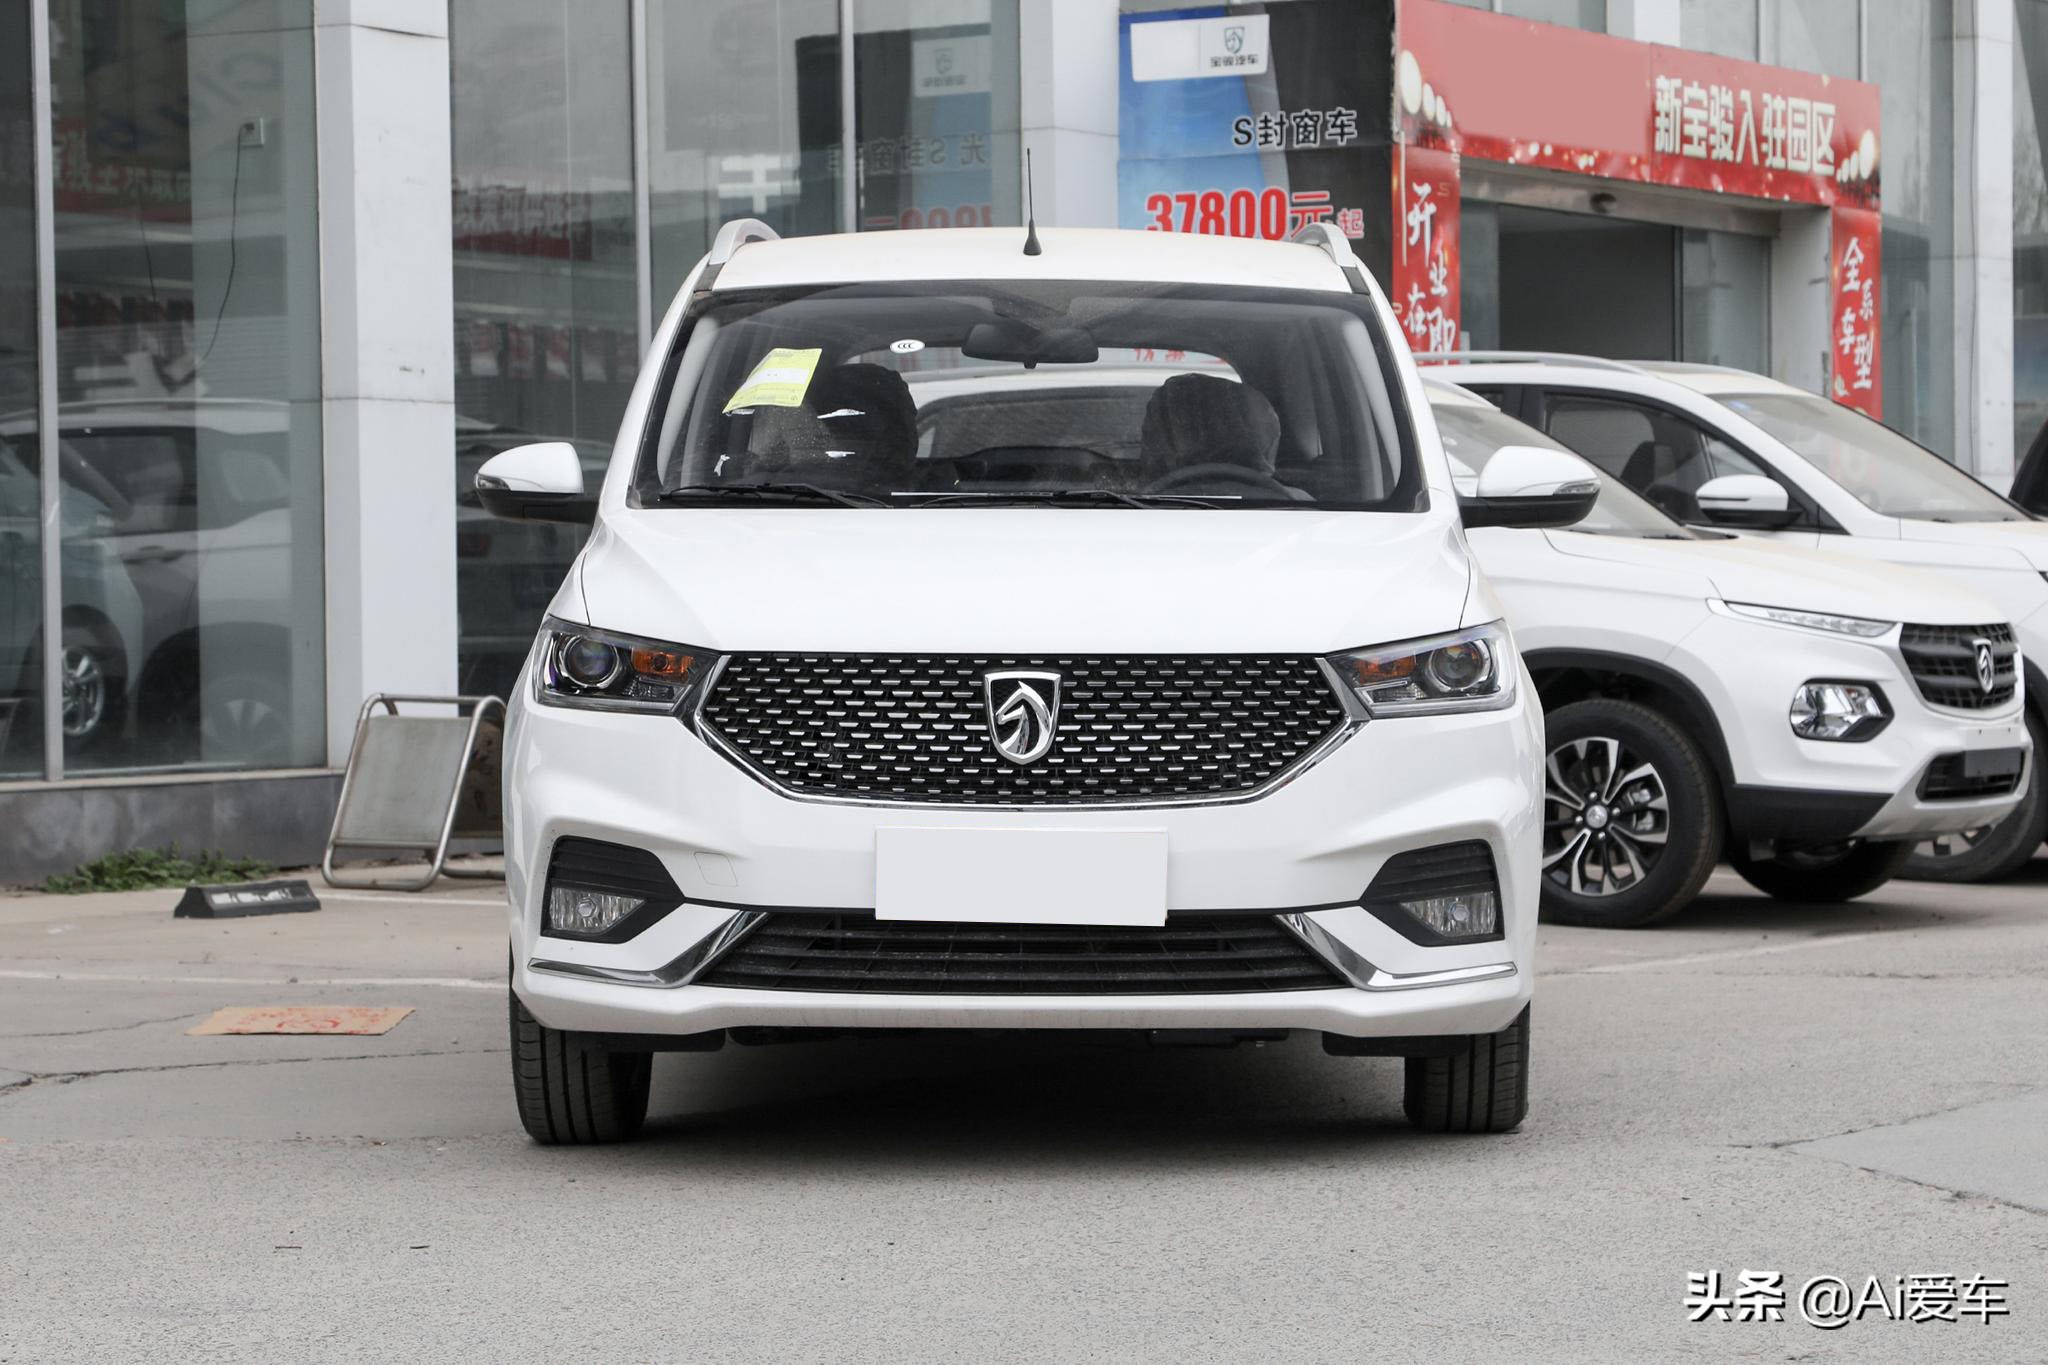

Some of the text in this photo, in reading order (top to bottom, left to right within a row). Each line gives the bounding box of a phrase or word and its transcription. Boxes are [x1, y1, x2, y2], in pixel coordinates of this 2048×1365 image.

[1233, 107, 1357, 147] S封窗车
[1655, 74, 1836, 176] 新宝骏入驻园区
[1839, 236, 1875, 389] 全系车型
